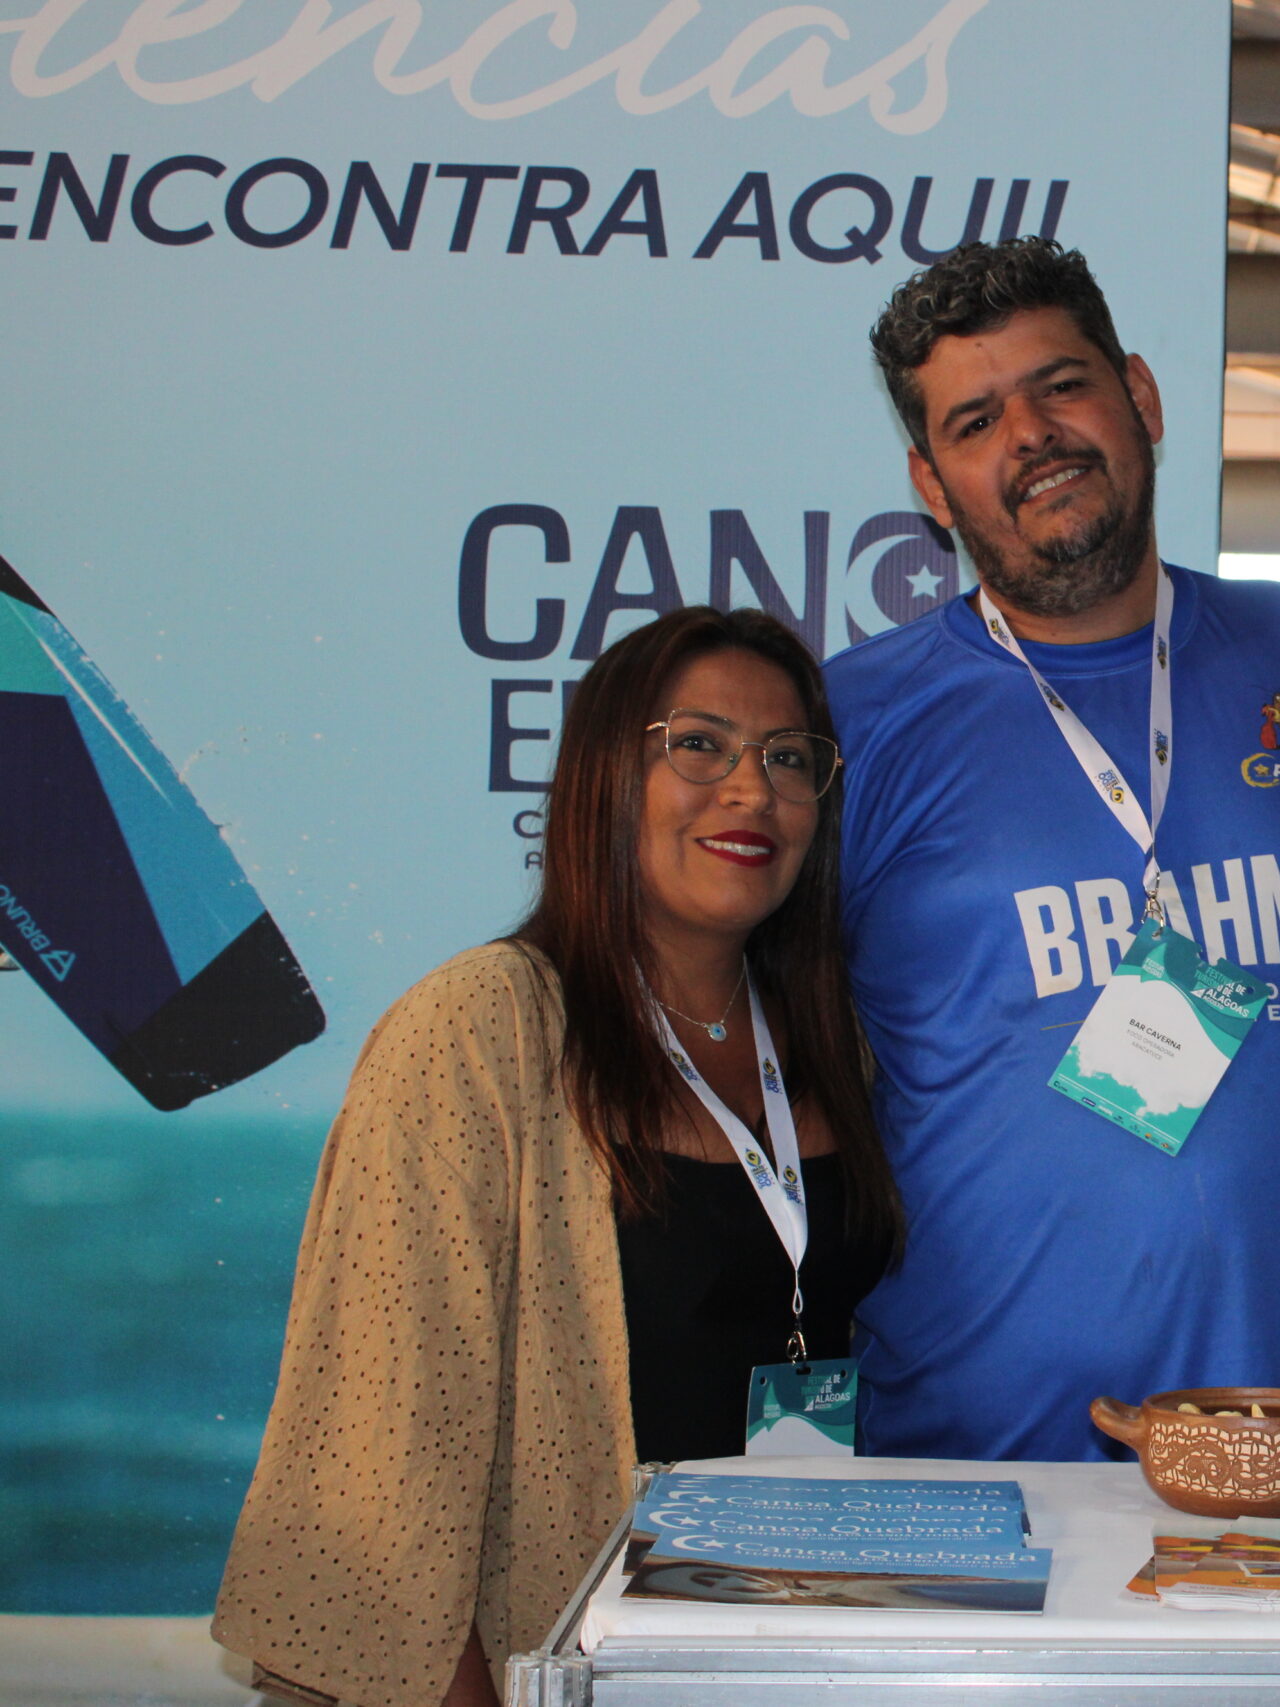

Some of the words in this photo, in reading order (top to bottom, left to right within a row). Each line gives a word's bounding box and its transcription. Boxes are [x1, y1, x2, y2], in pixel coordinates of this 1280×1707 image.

[1235, 983, 1247, 996] DE
[1205, 988, 1250, 1018] ALAGOAS
[1129, 1018, 1145, 1032] BAR
[1146, 1027, 1182, 1051] CAVERNA
[726, 1497, 830, 1508] Canoa
[843, 1501, 1007, 1511] Quebrada
[709, 1520, 818, 1533] Canoa
[830, 1524, 1003, 1534] Quebrada
[734, 1542, 845, 1556] Canoa
[859, 1550, 1037, 1561] Quebrada
